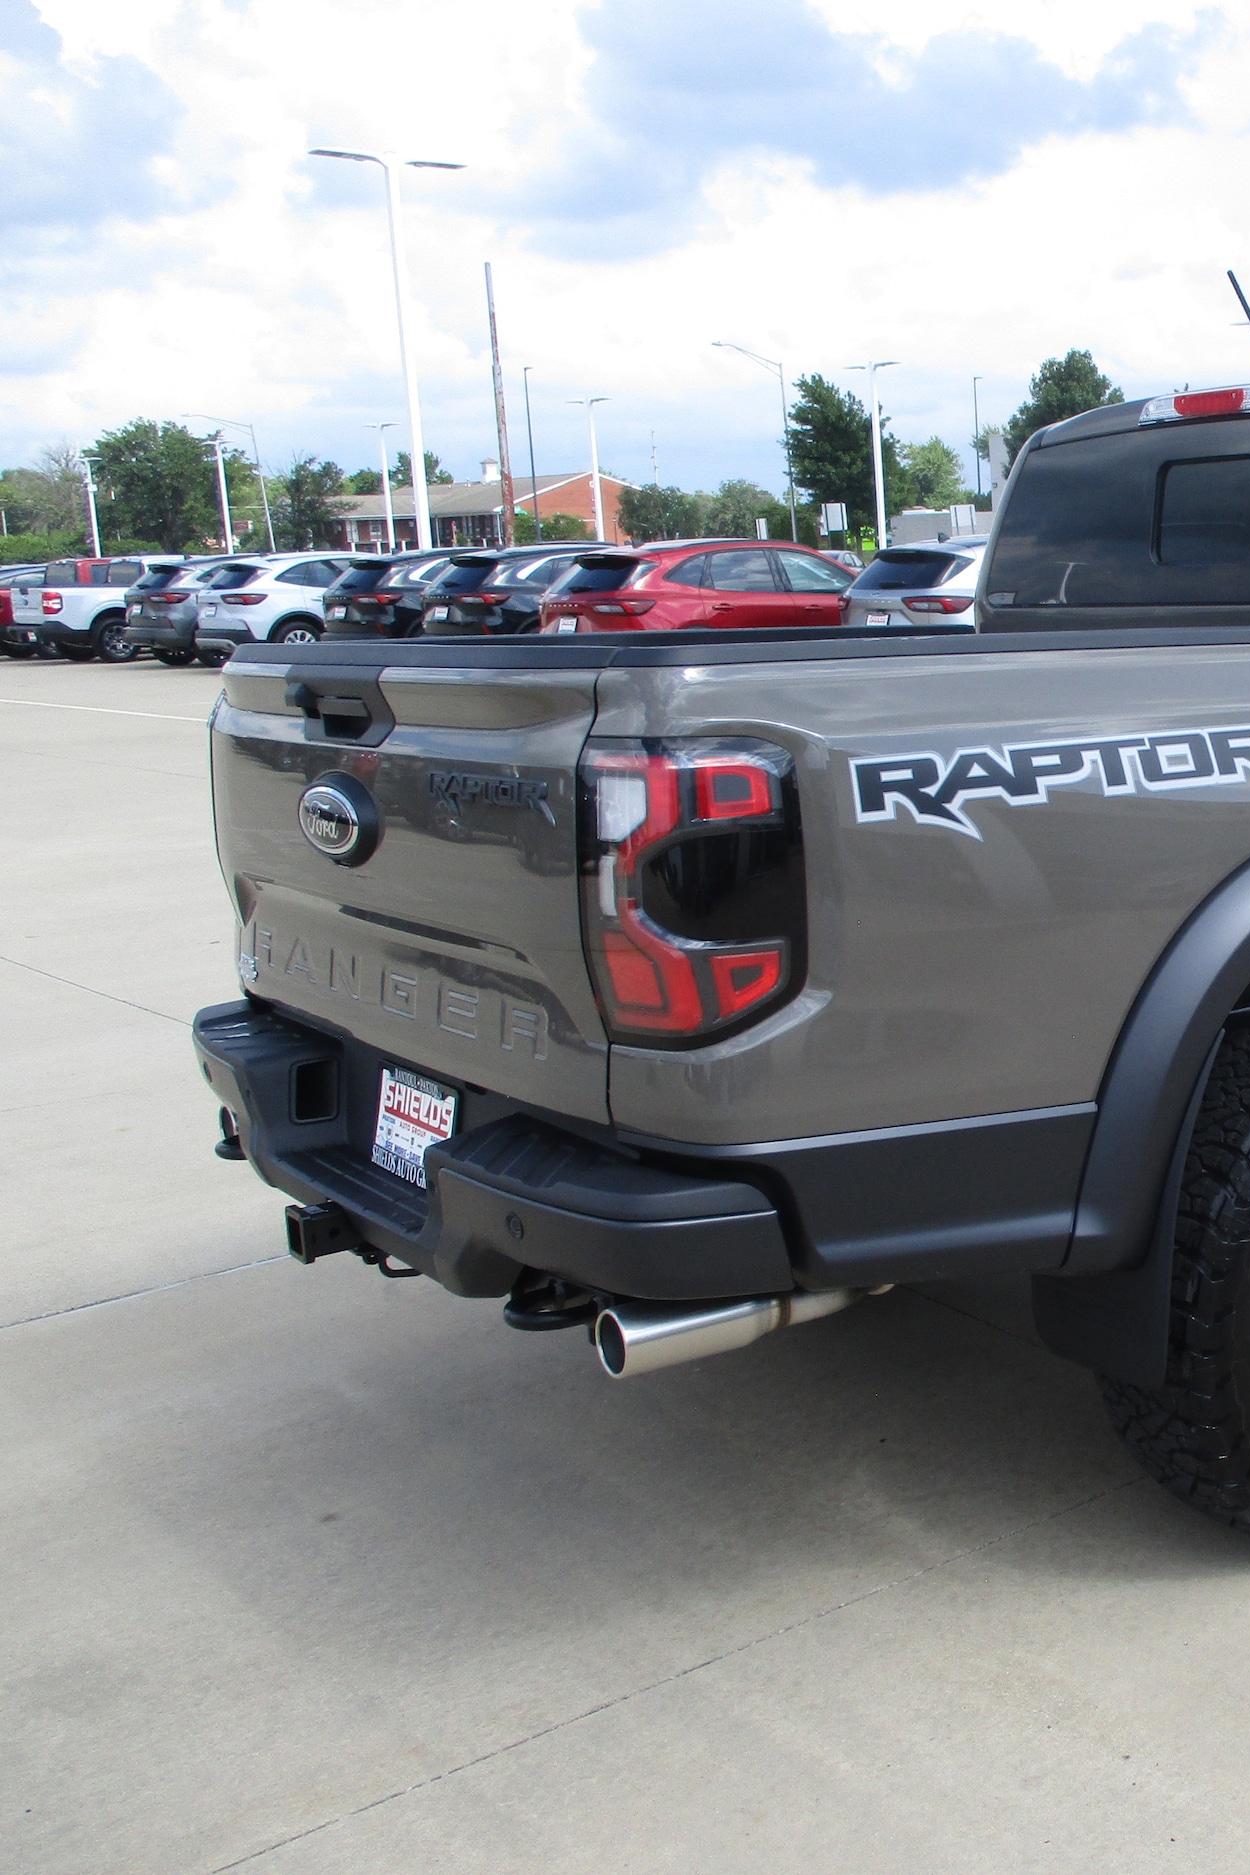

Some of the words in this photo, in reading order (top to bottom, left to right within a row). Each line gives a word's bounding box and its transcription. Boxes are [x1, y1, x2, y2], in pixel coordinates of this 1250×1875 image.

[306, 800, 340, 839] Ford
[429, 771, 557, 827] RAPTOR
[252, 920, 549, 1061] RANGER
[384, 1080, 453, 1133] SHIELDS
[395, 1157, 416, 1184] AUTO
